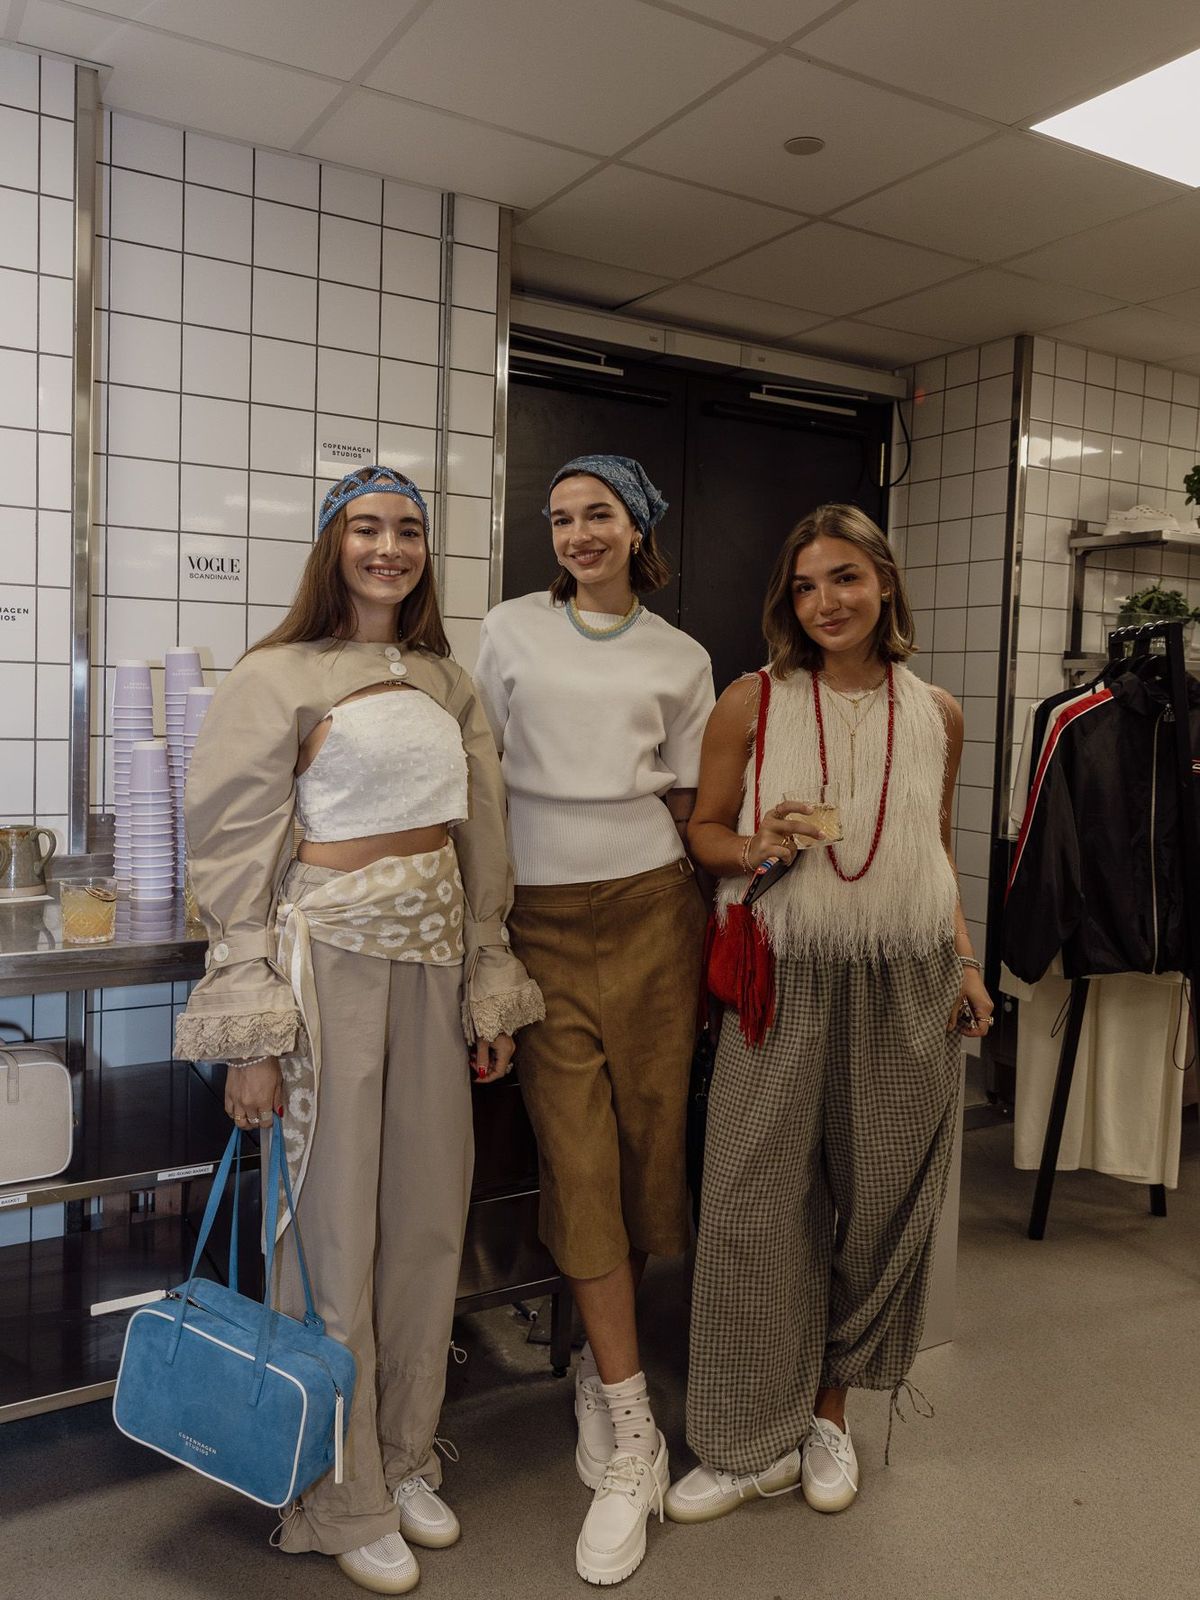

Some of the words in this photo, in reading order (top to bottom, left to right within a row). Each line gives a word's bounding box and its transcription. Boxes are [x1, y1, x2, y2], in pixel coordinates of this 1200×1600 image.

[322, 442, 371, 453] COPENHAGEN
[332, 450, 362, 459] STUDIOS
[188, 556, 241, 573] VOGUE
[189, 573, 240, 581] SCANDINAVIA
[178, 1431, 217, 1455] COPENHAGEN
